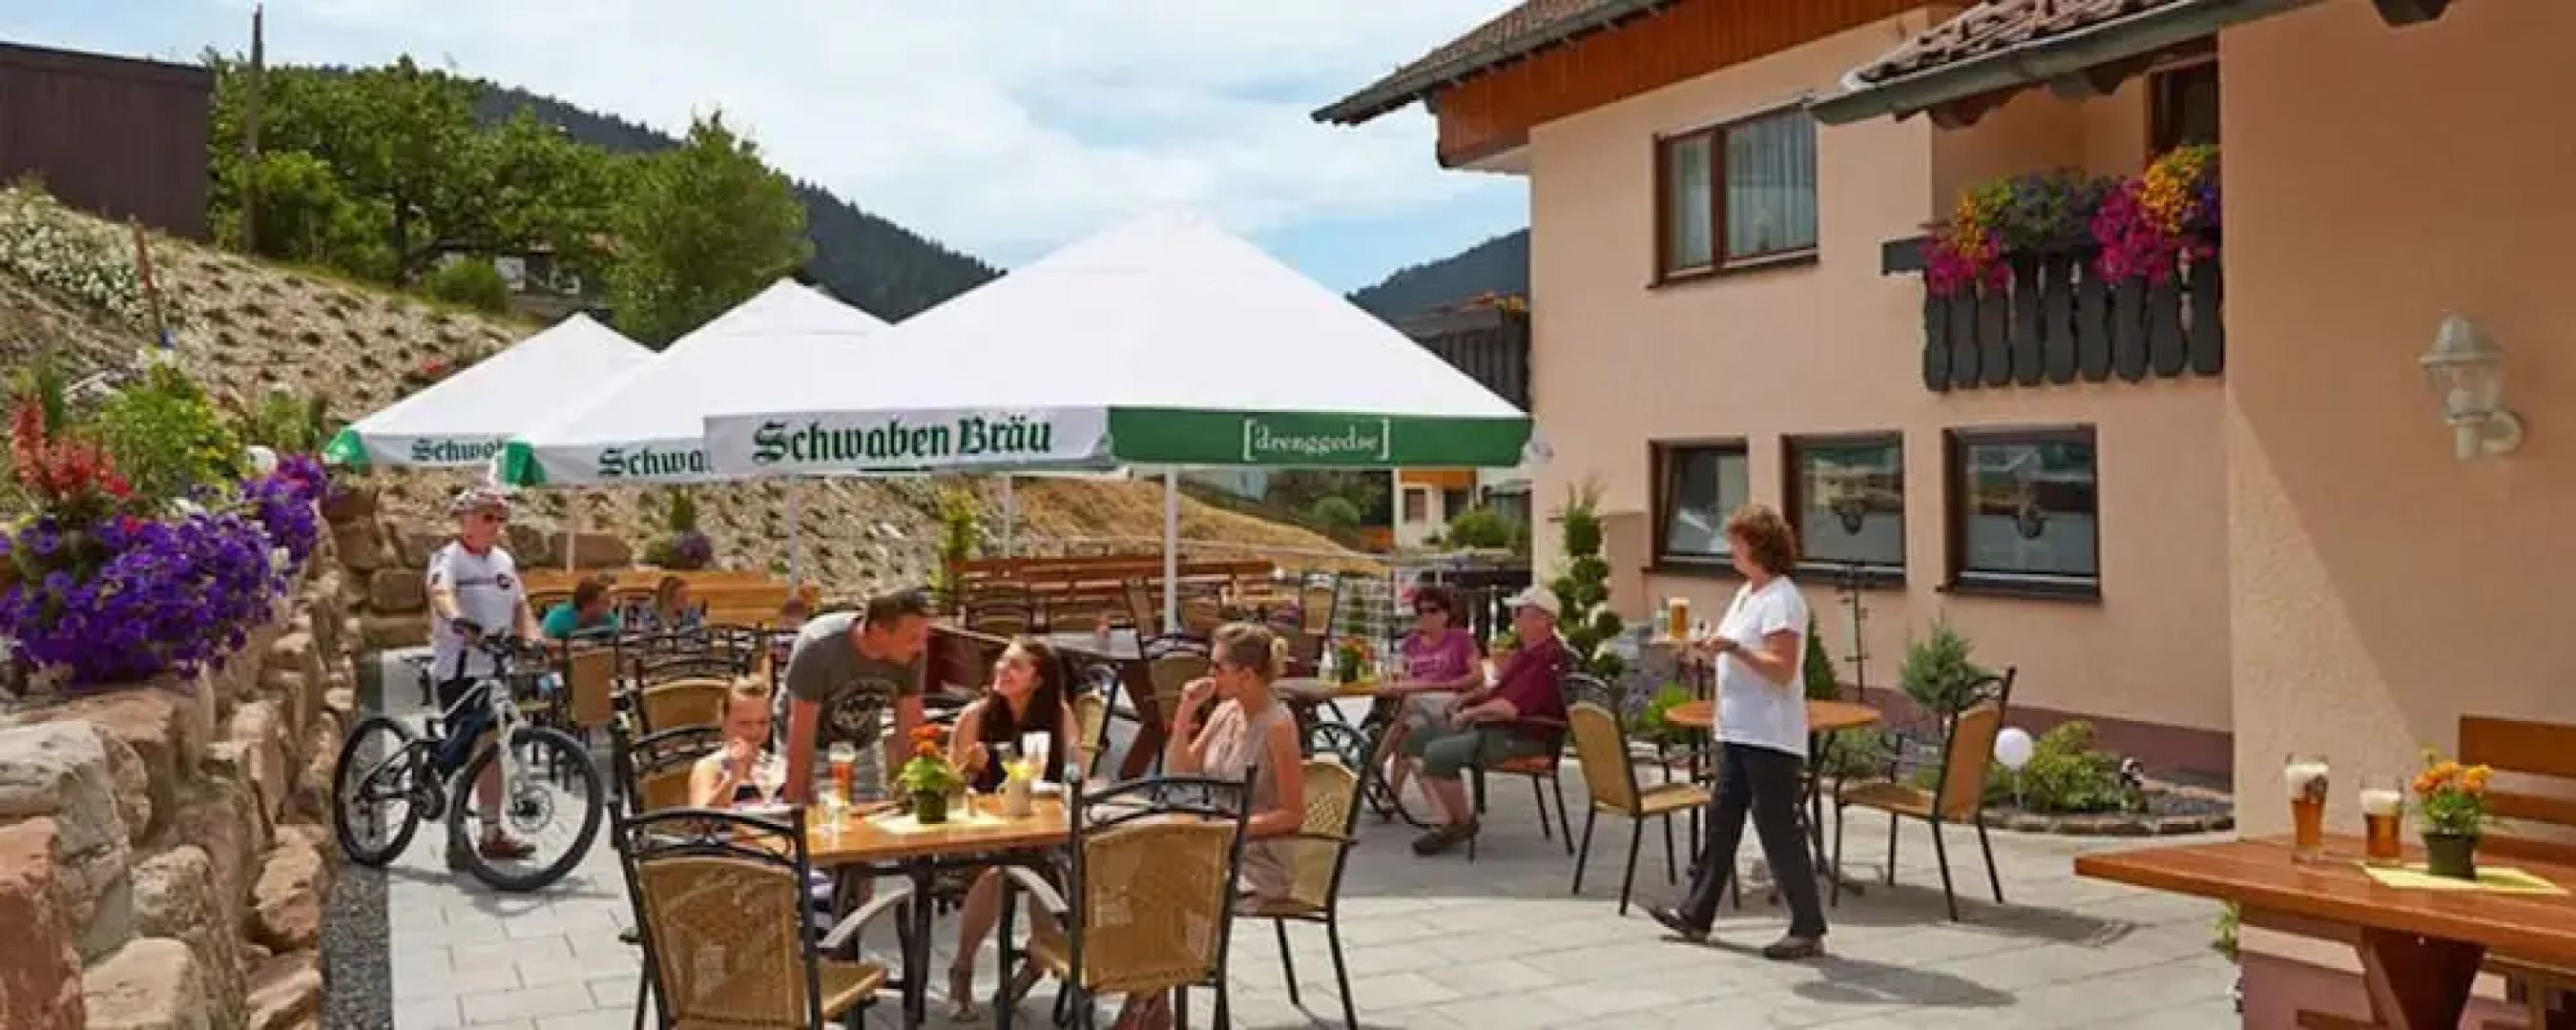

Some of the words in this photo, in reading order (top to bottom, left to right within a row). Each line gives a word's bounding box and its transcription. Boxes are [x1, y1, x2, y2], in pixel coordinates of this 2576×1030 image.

[411, 437, 504, 462] Schwa
[752, 418, 950, 465] Schwaben
[958, 414, 1051, 455] Bräu
[597, 447, 712, 479] Schwa
